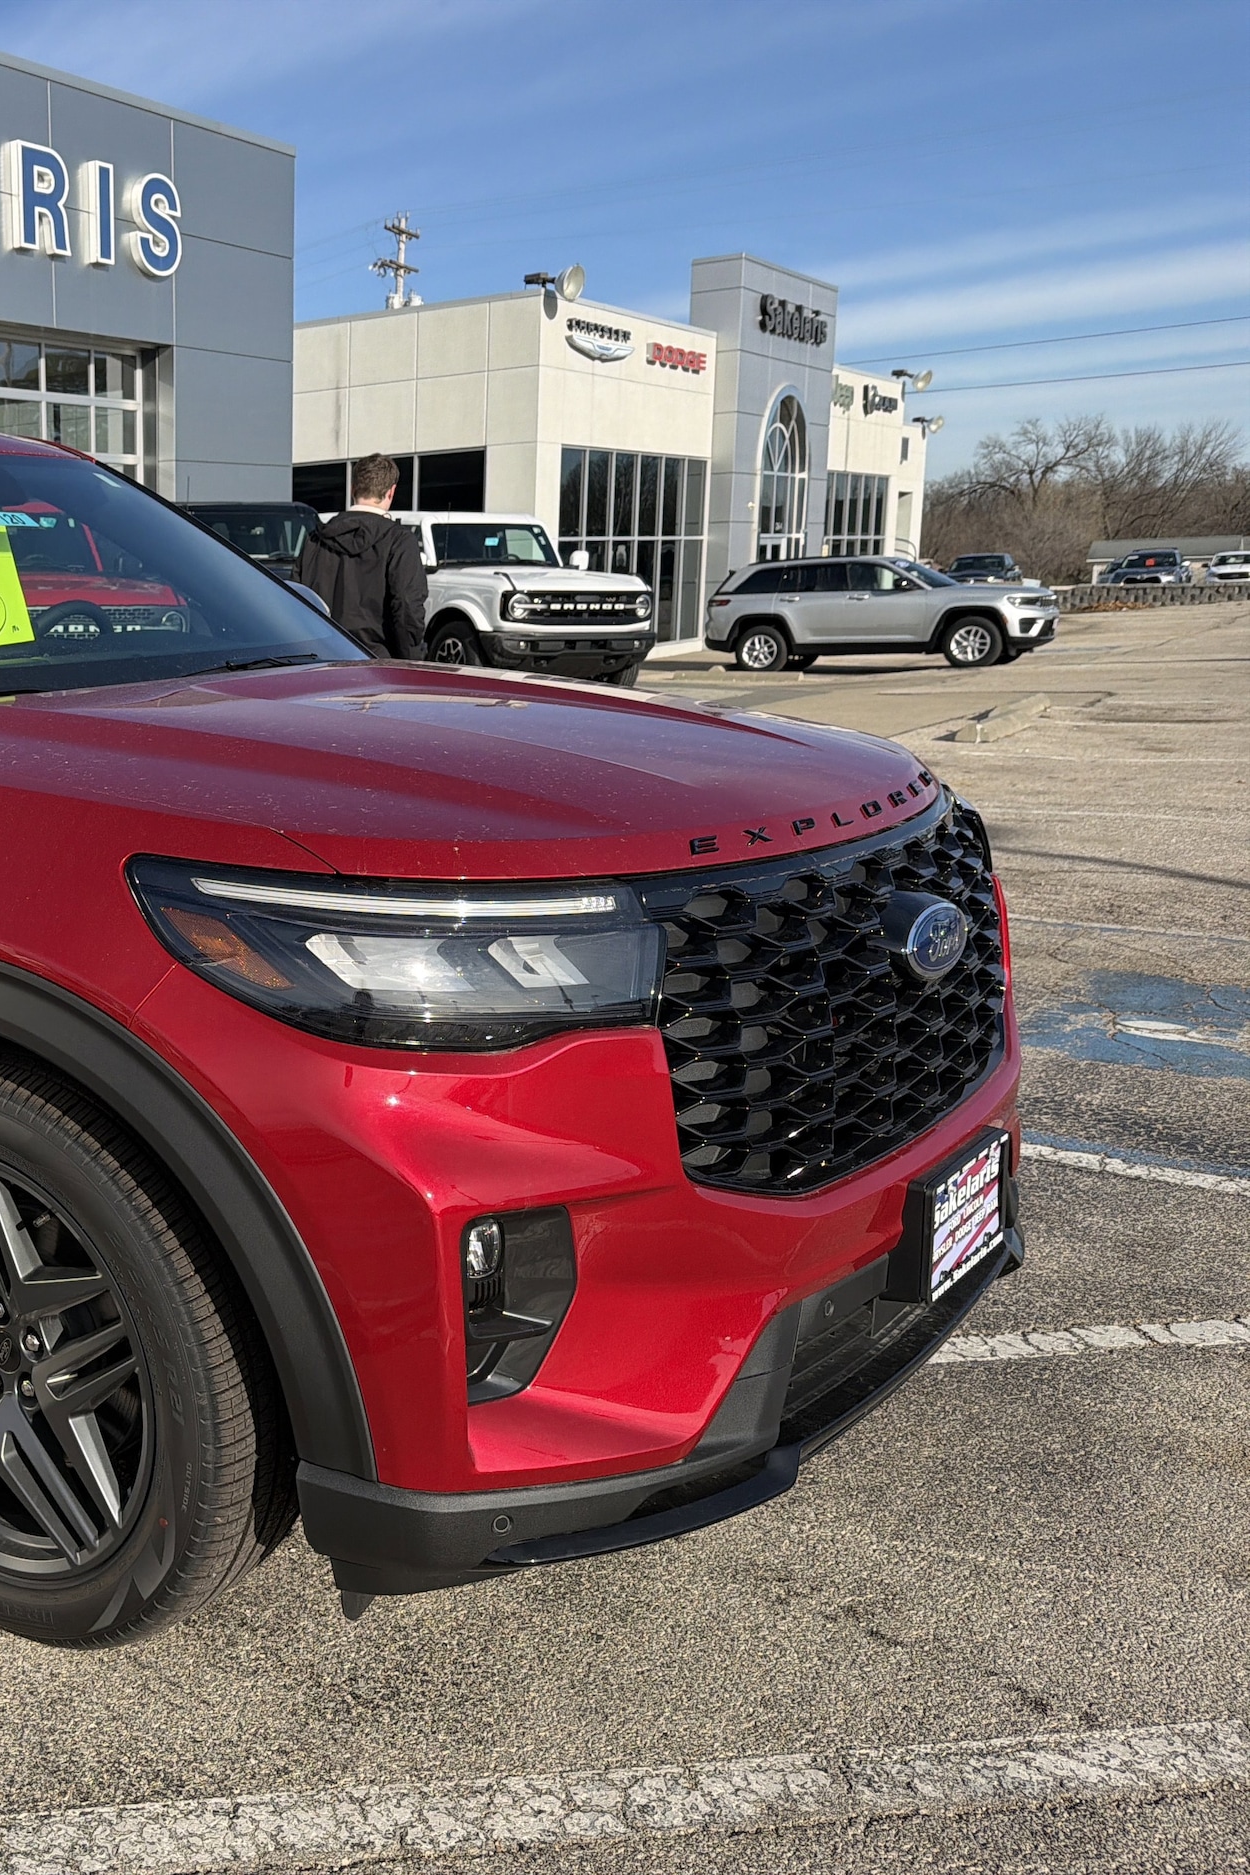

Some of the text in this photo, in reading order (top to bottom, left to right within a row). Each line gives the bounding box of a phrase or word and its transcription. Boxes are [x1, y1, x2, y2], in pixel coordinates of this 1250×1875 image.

[567, 317, 631, 345] CHRYSLER
[760, 294, 828, 346] Sakelaris
[651, 342, 707, 372] DODGE
[549, 602, 626, 611] BRONCO
[688, 769, 934, 857] EXPLORER
[927, 913, 961, 963] Ford
[181, 1462, 193, 1512] OUTSIDE
